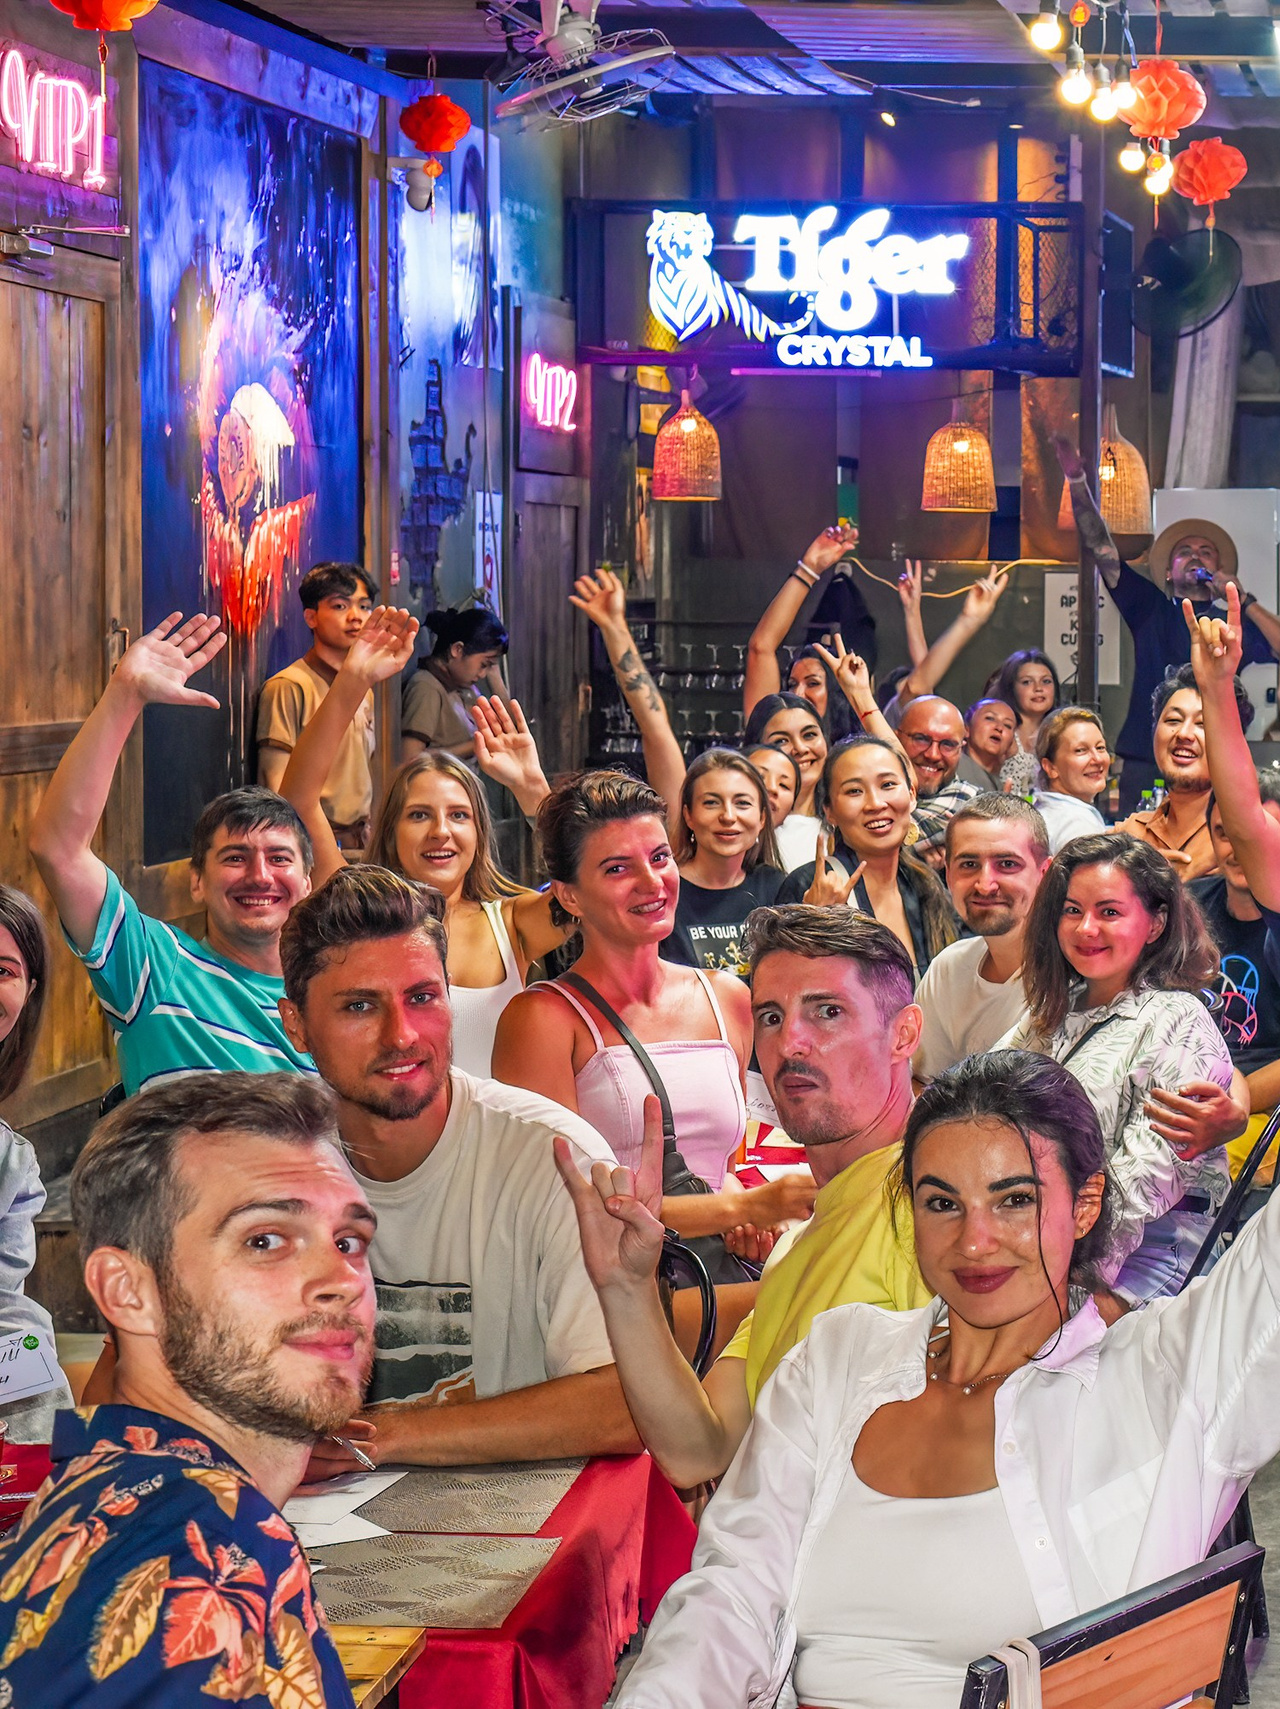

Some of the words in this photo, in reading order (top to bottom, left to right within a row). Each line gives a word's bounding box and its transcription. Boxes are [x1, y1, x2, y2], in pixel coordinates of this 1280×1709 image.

[2, 49, 106, 190] VIP1
[733, 205, 969, 331] Tiger
[777, 334, 933, 367] CRYSTAL
[528, 352, 577, 431] VIP2
[690, 926, 707, 940] BE
[707, 925, 738, 938] YOUR
